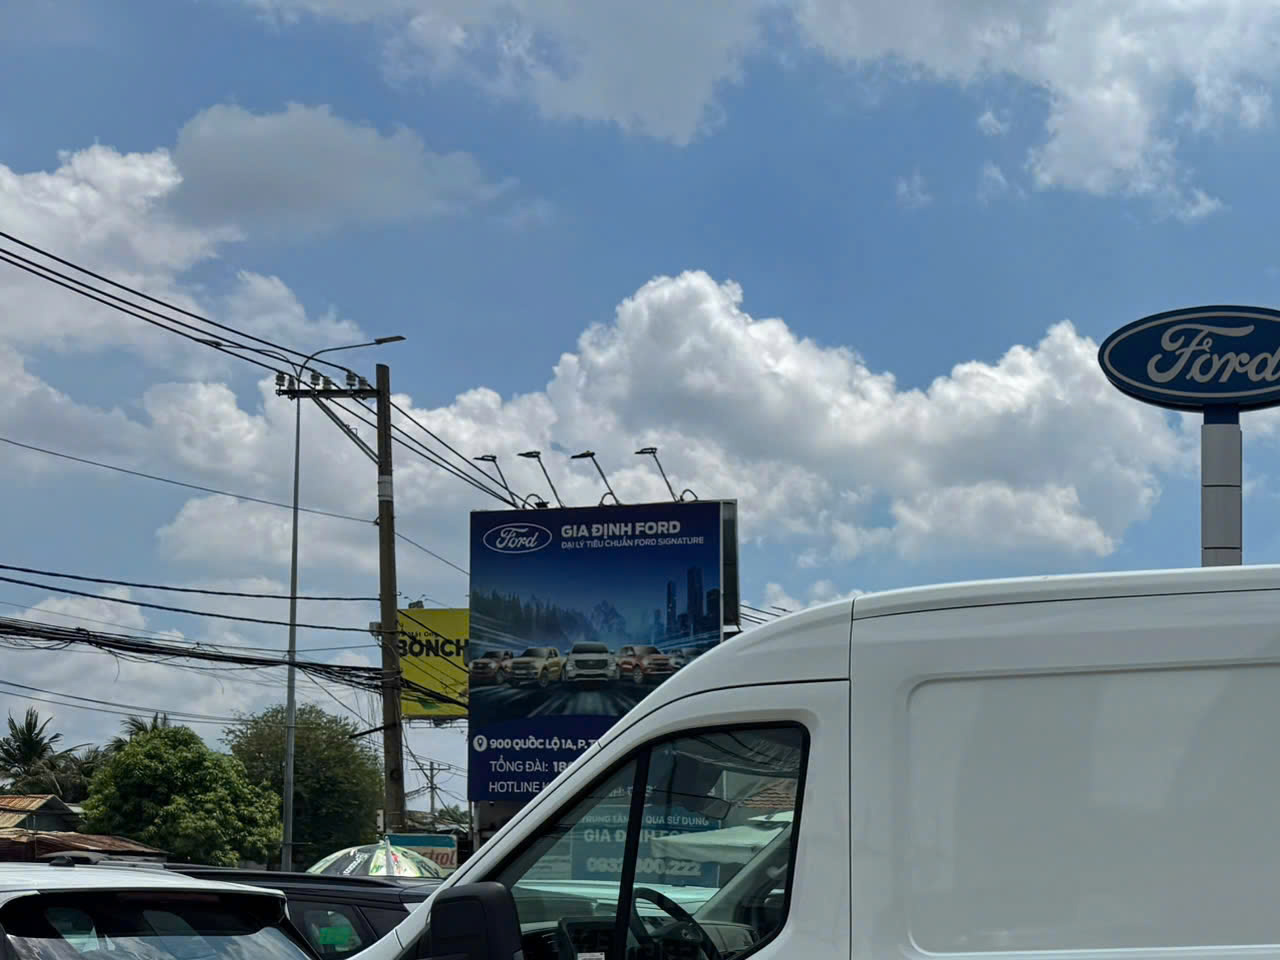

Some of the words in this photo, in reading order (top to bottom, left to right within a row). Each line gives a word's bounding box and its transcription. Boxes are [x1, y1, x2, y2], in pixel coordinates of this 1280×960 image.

[561, 524, 590, 538] GIA
[592, 522, 632, 539] ĐỊNH
[634, 520, 681, 535] FORD
[496, 527, 539, 549] Ford
[634, 538, 657, 547] FORD
[657, 536, 705, 546] SIGNATURE
[490, 739, 512, 749] 900
[546, 736, 561, 752] LỘ
[577, 739, 588, 749] P.
[489, 755, 524, 772] TỔNG
[525, 758, 549, 772] ĐÀI:
[489, 781, 541, 793] HOTLINE
[584, 829, 611, 843] GIA
